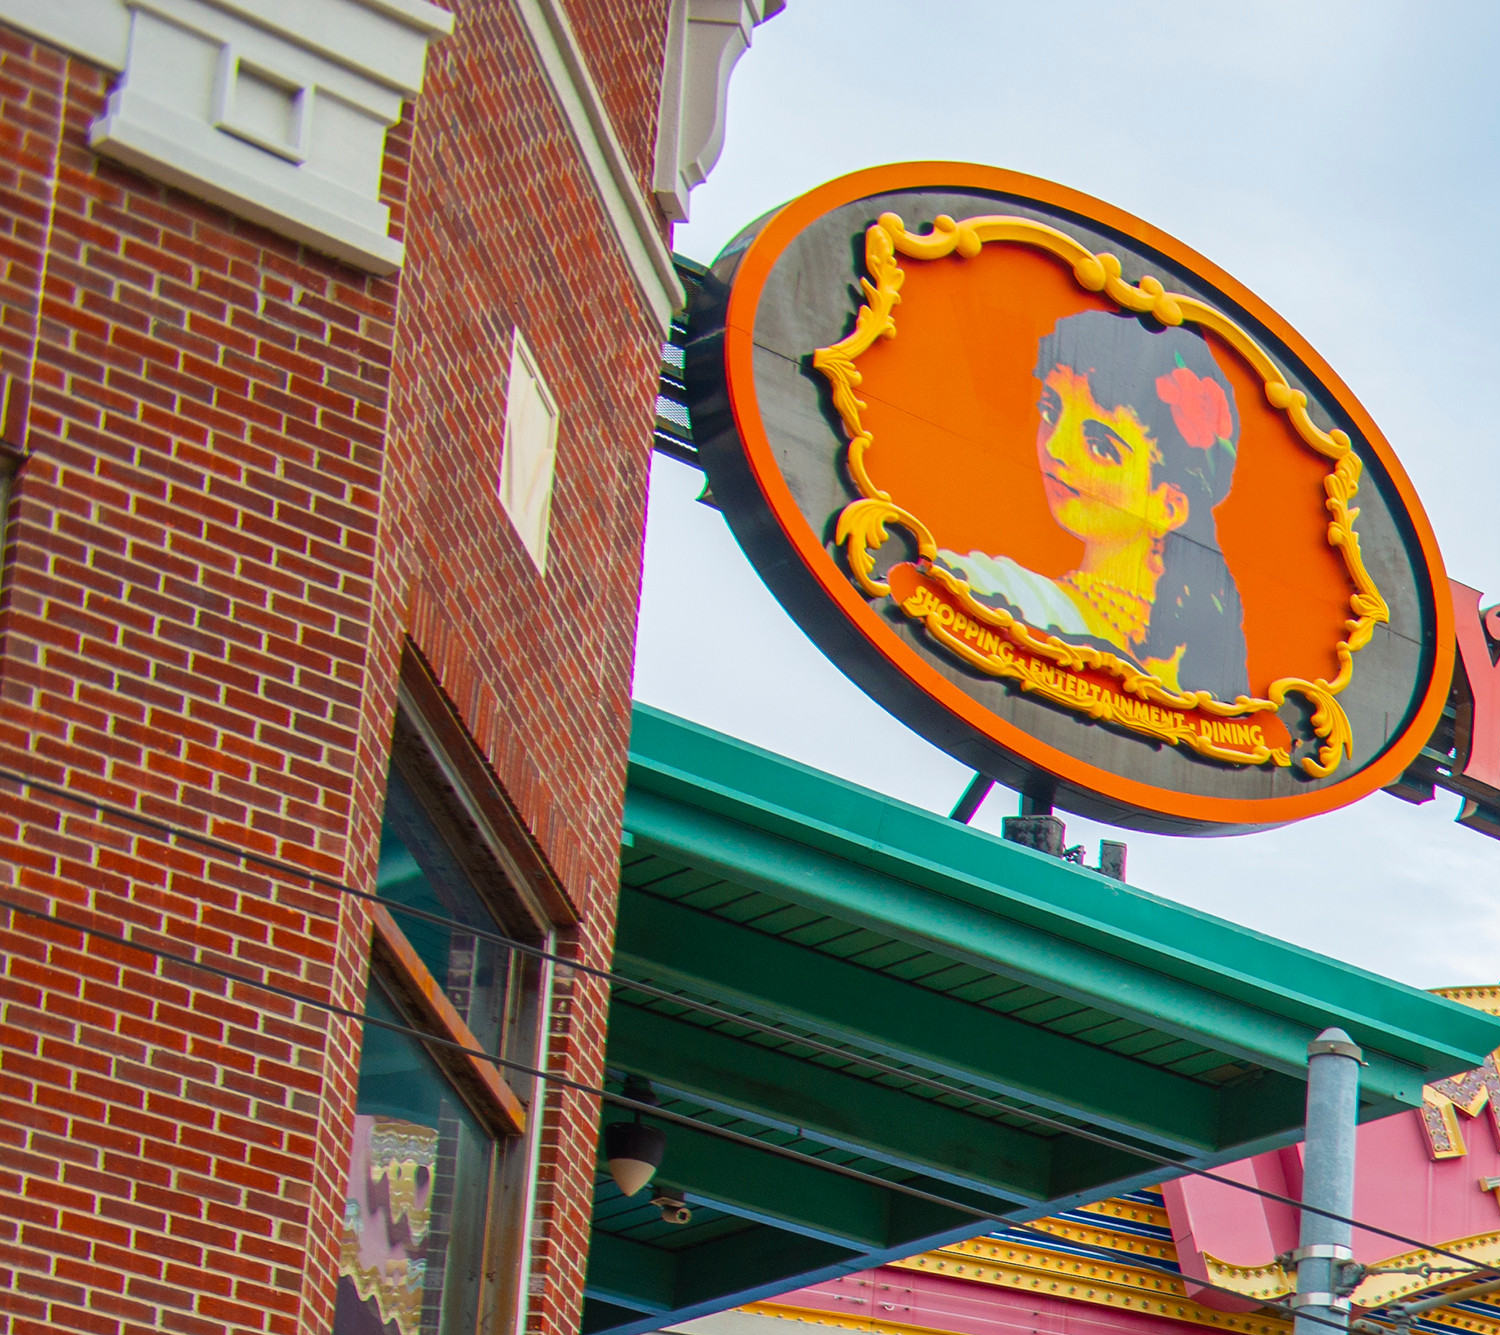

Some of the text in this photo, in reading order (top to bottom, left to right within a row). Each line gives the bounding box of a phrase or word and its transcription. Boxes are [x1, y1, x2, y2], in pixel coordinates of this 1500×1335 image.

[915, 586, 1265, 748] SHOPPING ENTERTAINMENT DINING
